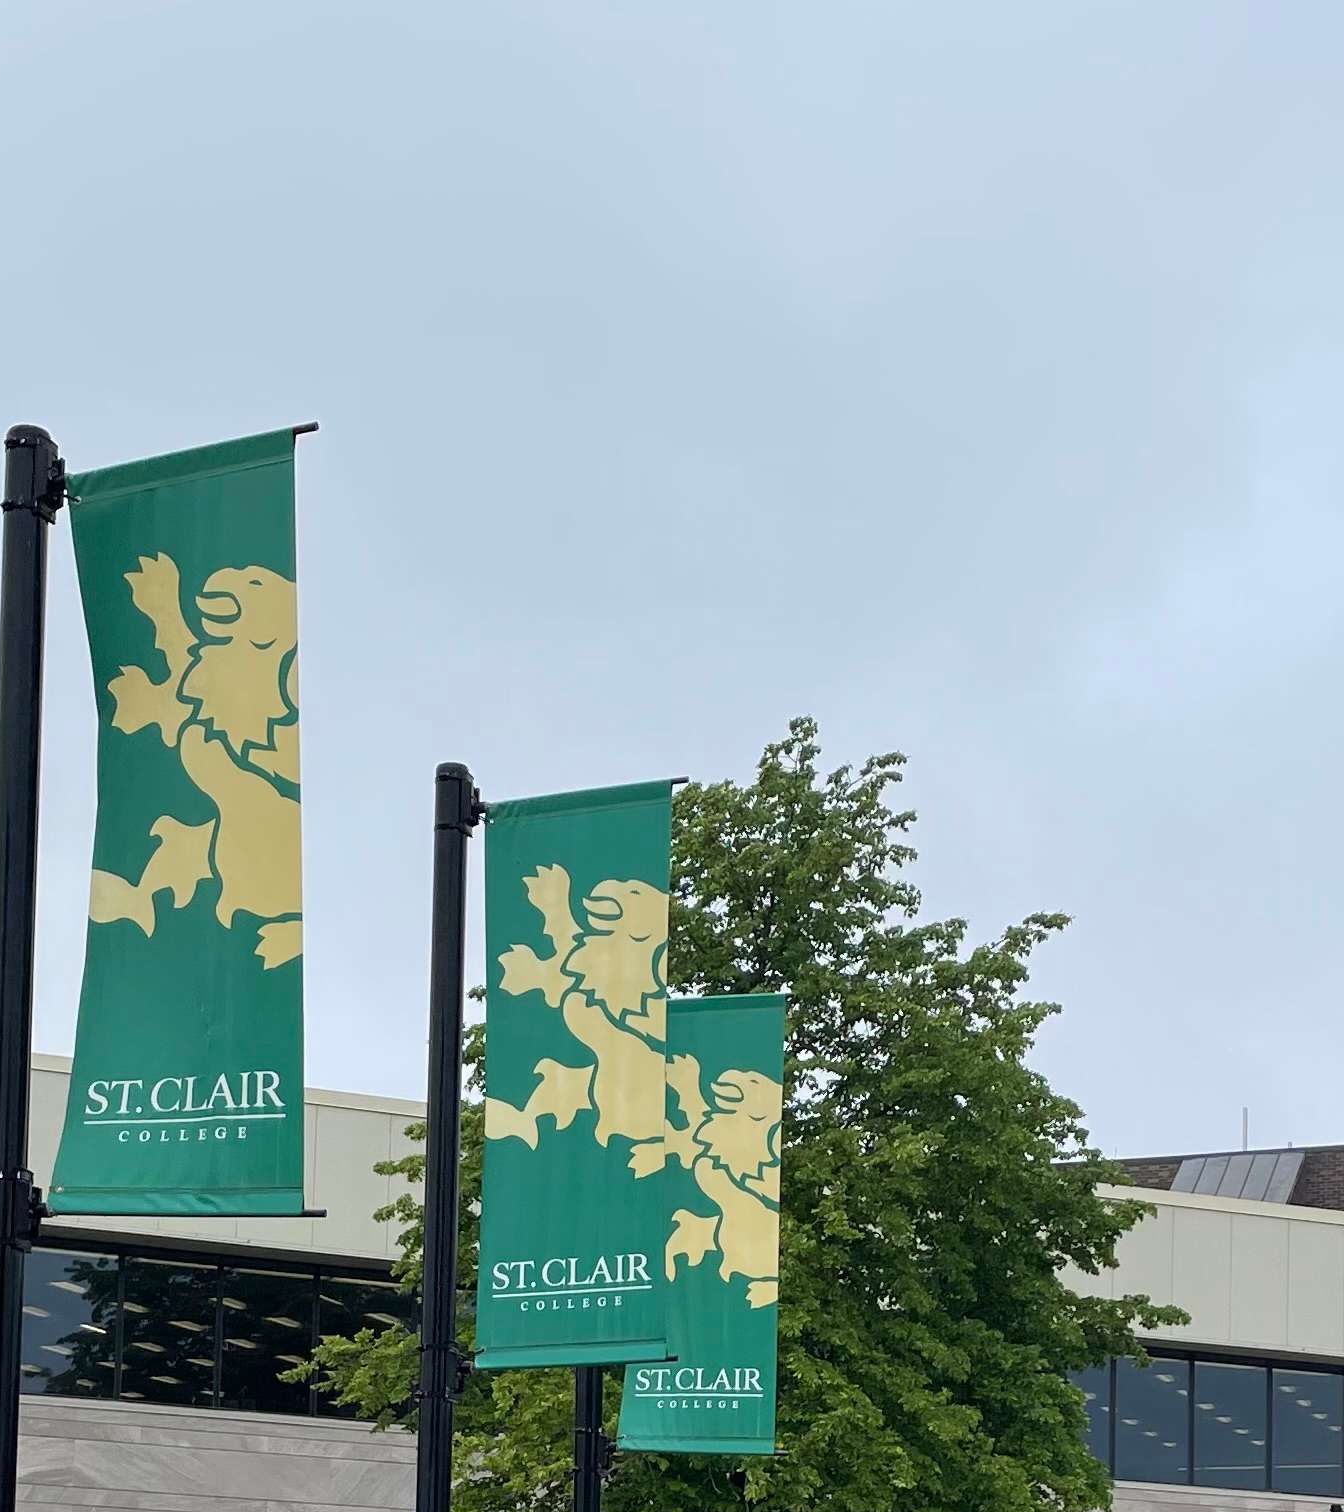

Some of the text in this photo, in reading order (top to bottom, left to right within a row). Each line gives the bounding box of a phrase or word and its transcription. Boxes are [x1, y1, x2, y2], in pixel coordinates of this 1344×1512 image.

[84, 1070, 286, 1115] ST. CLAIR
[118, 1126, 247, 1142] COLLEGE
[492, 1253, 652, 1290] ST. CLAIR
[520, 1295, 623, 1311] COLLEGE
[635, 1367, 763, 1391] ST. CLAIR
[657, 1400, 739, 1409] COLLEGE
